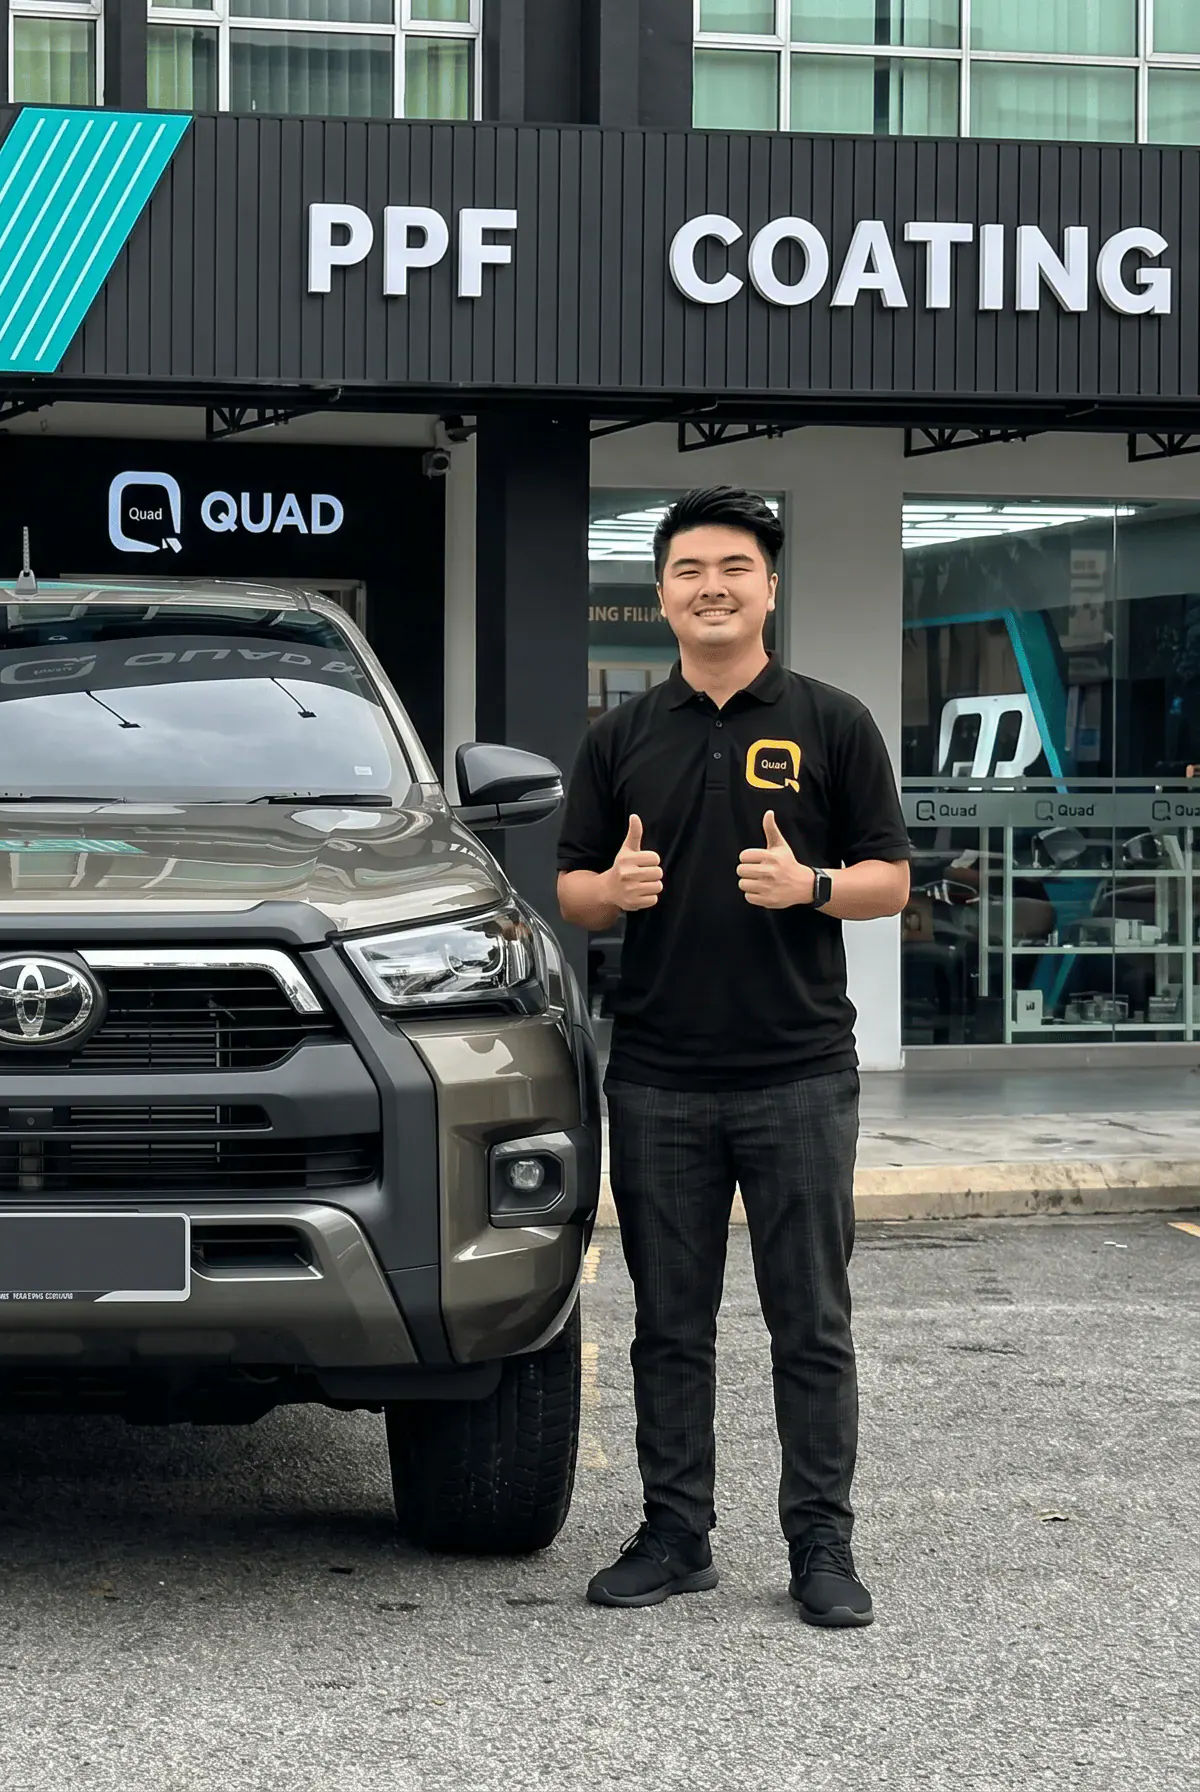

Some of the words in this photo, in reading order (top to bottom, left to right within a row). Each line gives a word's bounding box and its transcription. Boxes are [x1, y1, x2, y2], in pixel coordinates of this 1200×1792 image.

[308, 203, 518, 298] PPF
[668, 213, 1172, 316] COATING
[128, 507, 163, 521] Quad
[200, 490, 345, 535] QUAD
[761, 759, 787, 770] Quad
[939, 804, 977, 817] Quad
[1057, 804, 1095, 816] Quad
